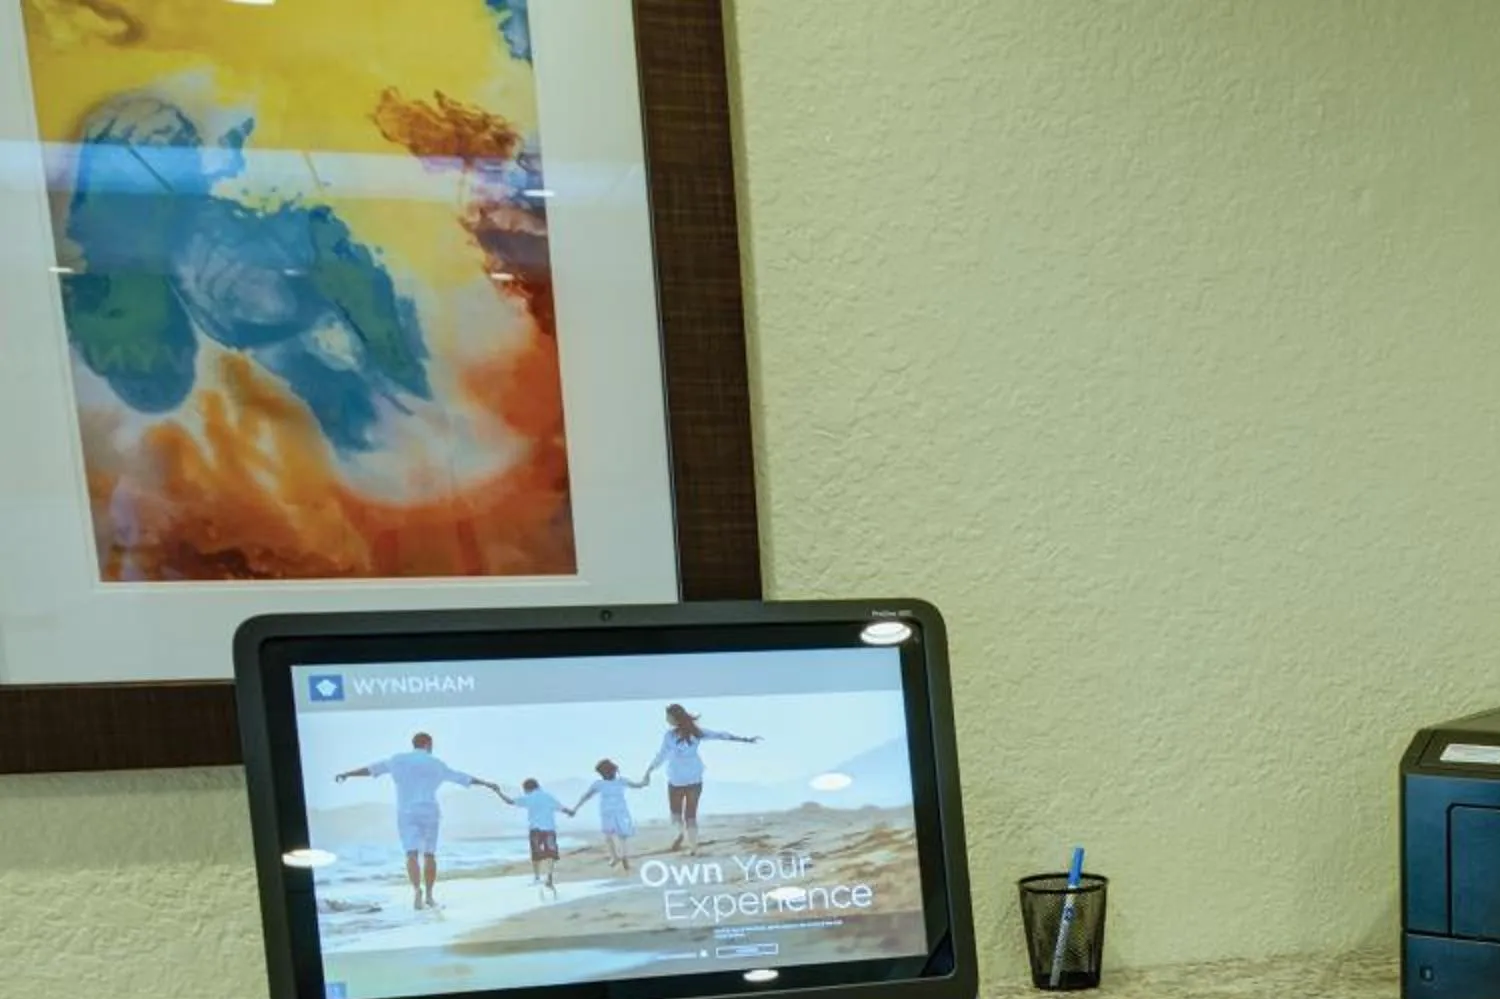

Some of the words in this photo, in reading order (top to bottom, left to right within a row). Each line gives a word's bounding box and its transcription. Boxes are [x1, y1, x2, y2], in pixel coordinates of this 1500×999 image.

[352, 674, 476, 696] WYNDHAM
[640, 859, 724, 888] Own
[732, 854, 813, 881] Your
[663, 882, 873, 923] Experience
